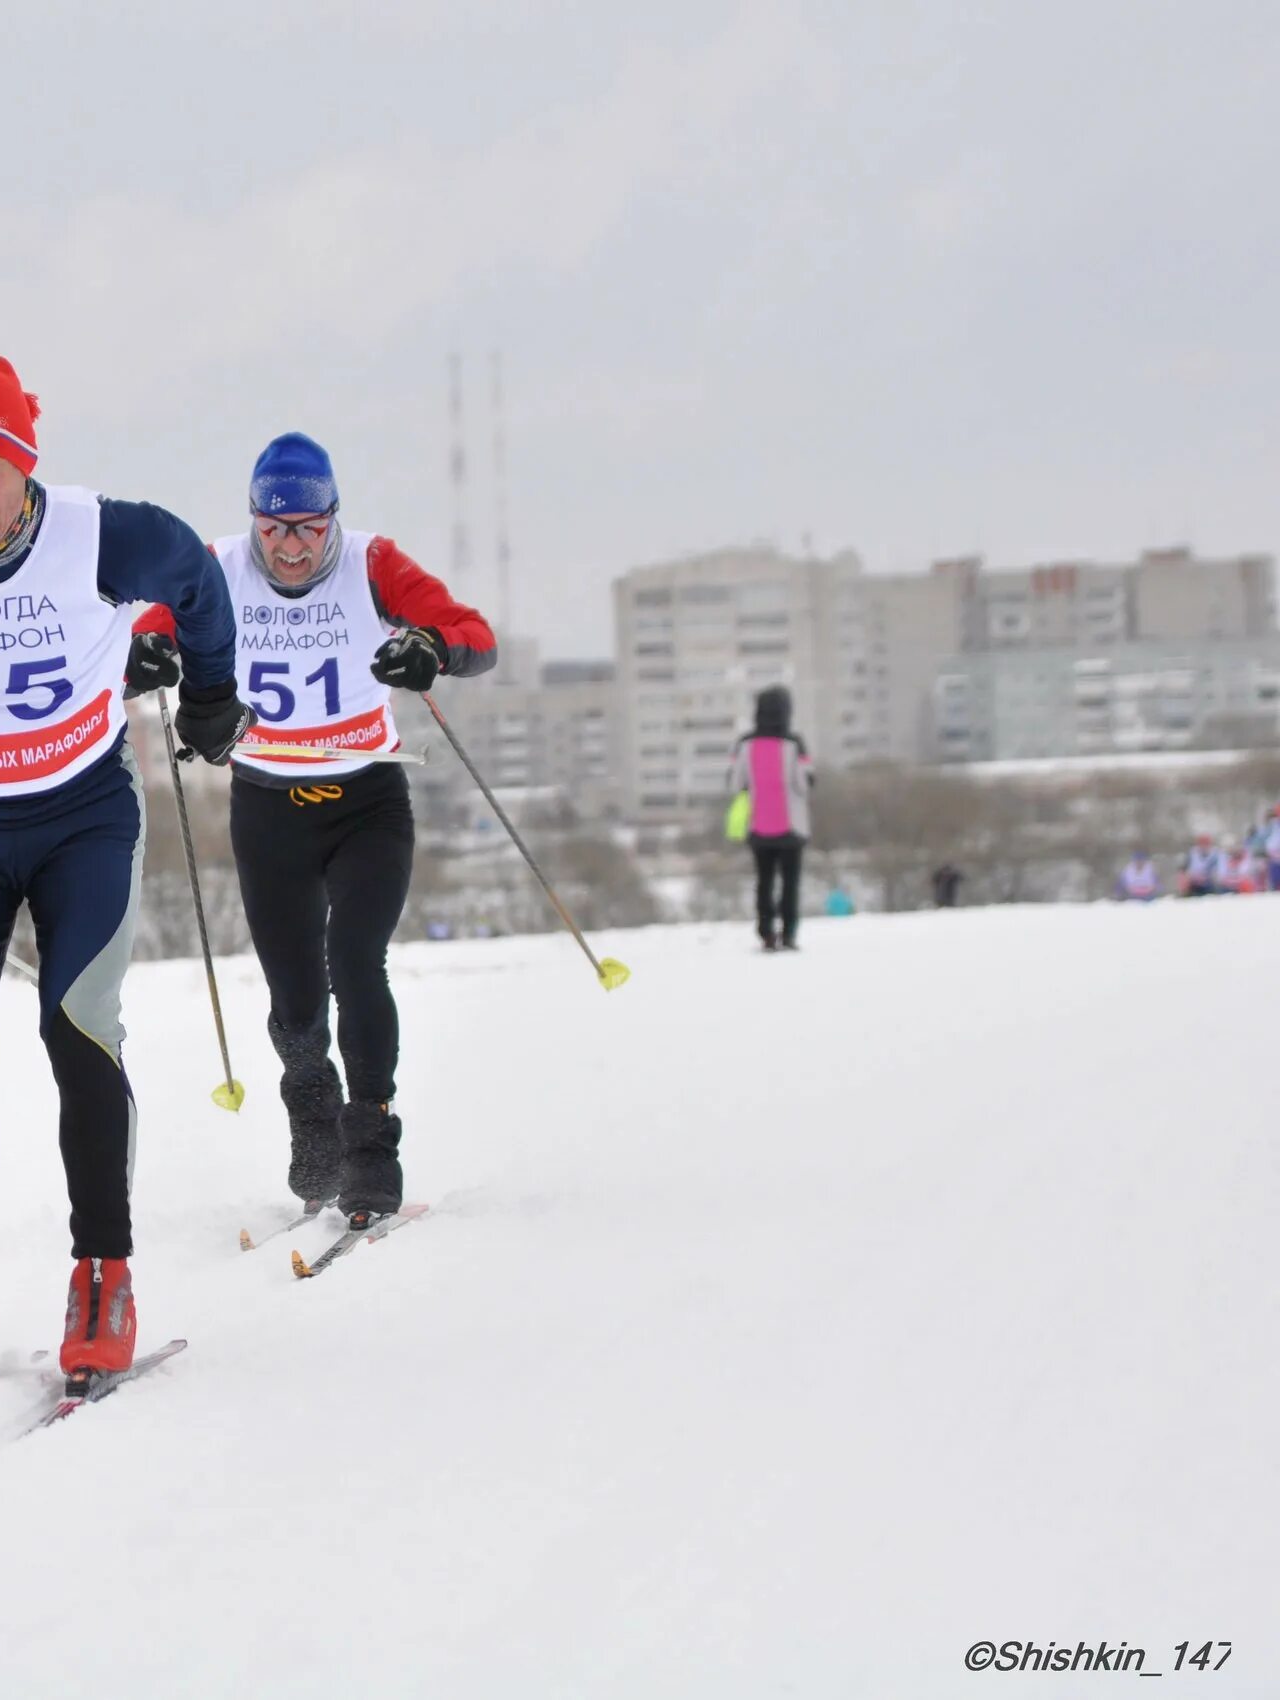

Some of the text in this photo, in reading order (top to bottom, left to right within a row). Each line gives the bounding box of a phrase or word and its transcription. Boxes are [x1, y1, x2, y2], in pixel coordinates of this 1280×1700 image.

[242, 602, 346, 625] ВОЛОГДА
[241, 627, 349, 651] МАРАФОН
[248, 657, 341, 722] 51
